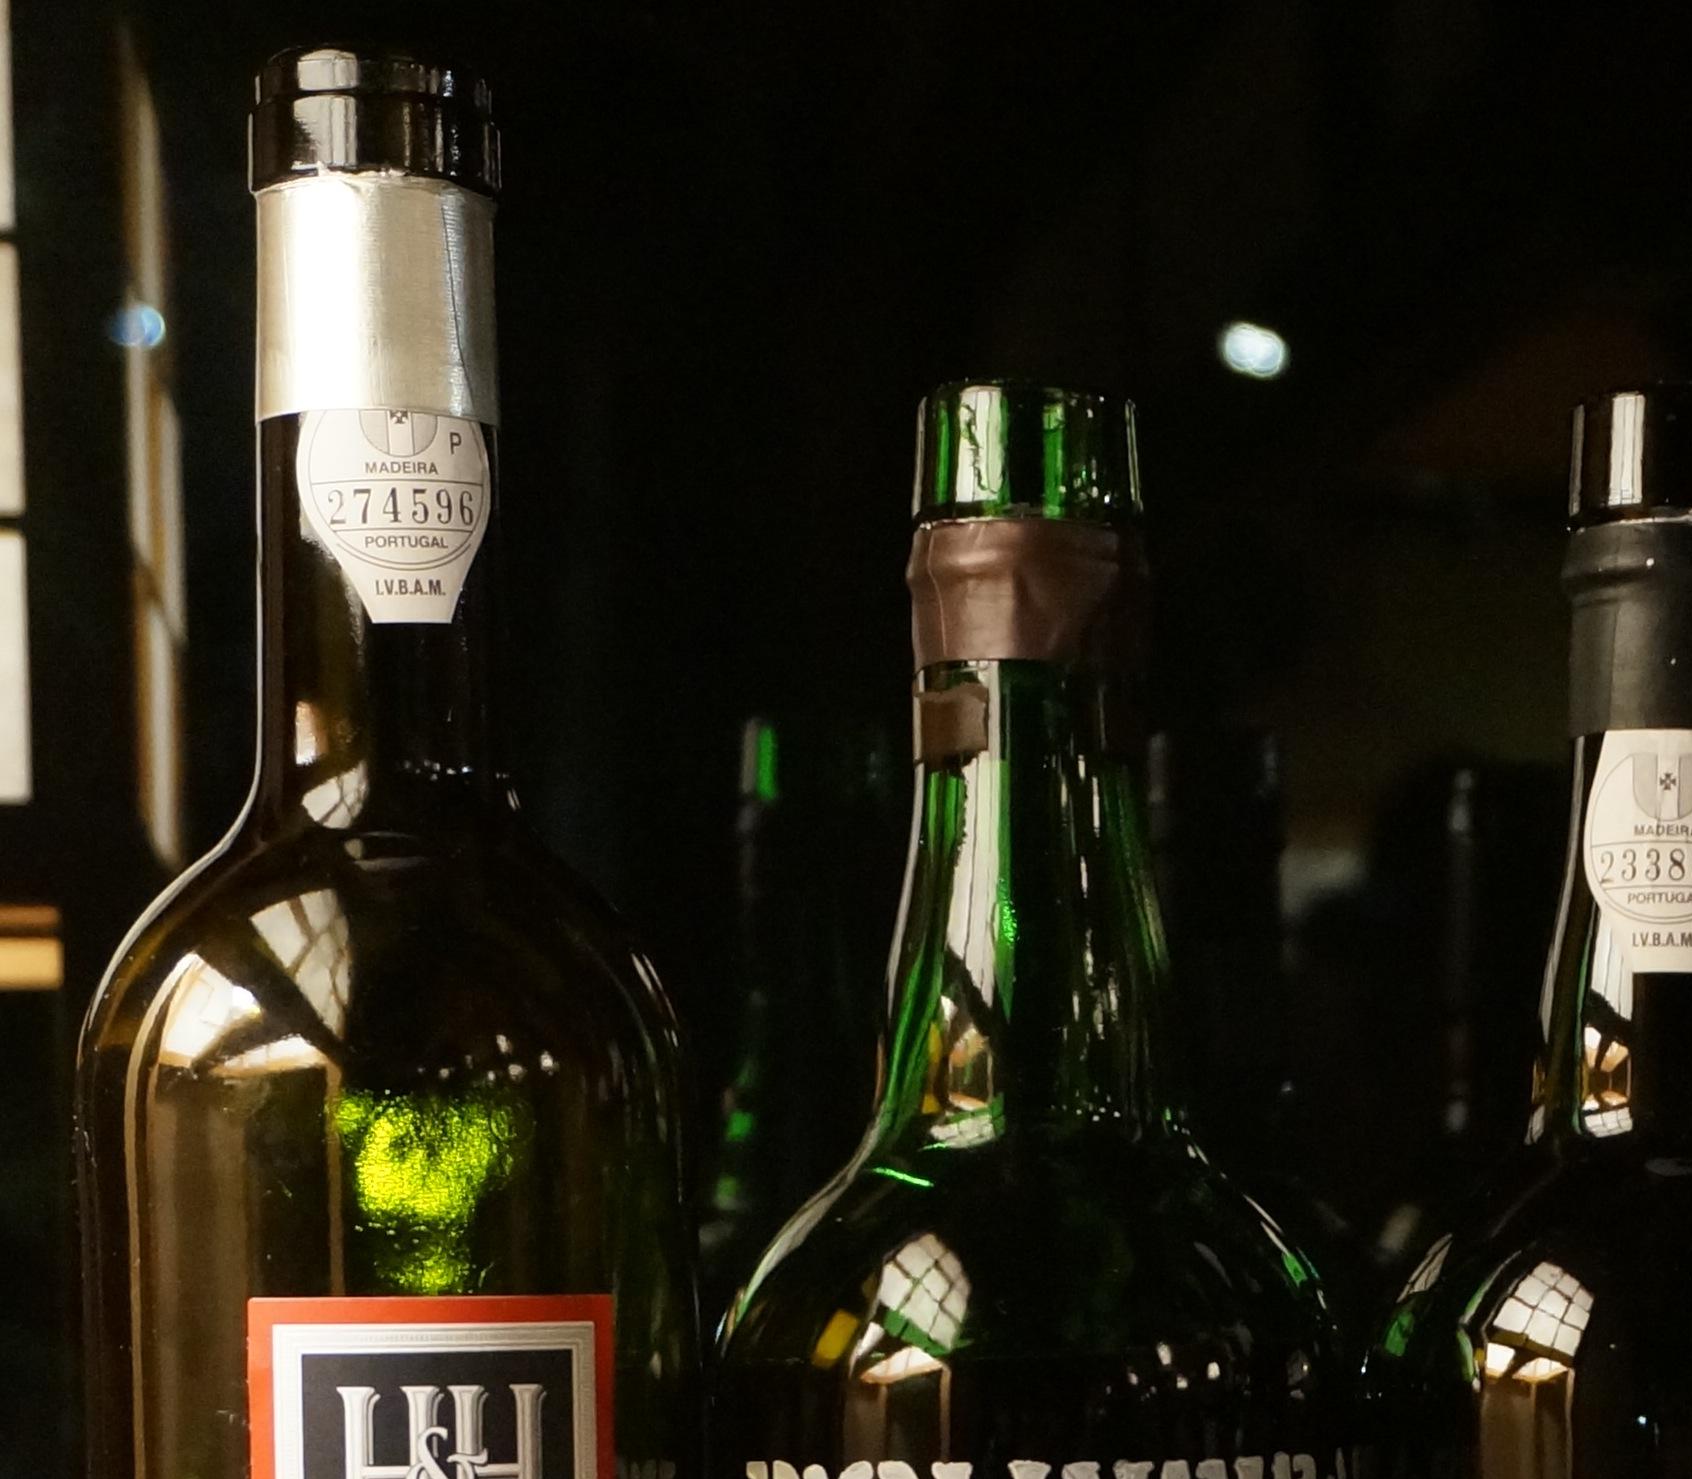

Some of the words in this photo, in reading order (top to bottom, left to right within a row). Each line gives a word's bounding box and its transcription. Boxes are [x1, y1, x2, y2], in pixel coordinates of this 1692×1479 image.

[450, 432, 462, 454] P
[365, 461, 439, 475] MADEIRA
[328, 487, 475, 526] 274596
[364, 535, 449, 549] PORTUGAL
